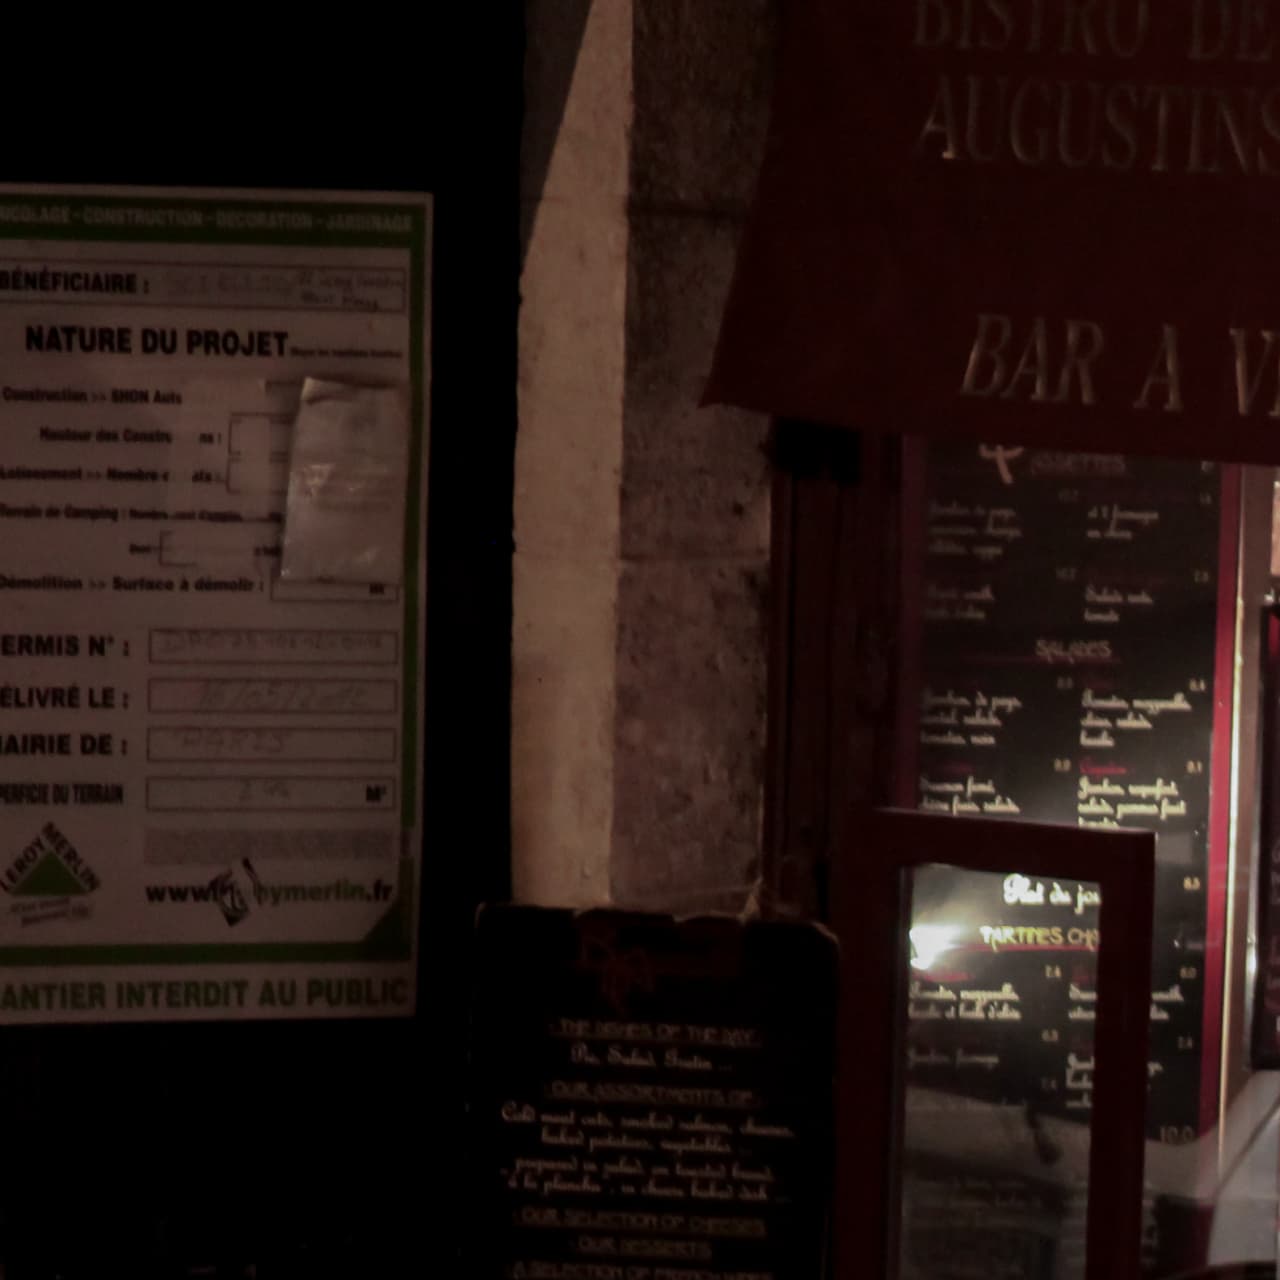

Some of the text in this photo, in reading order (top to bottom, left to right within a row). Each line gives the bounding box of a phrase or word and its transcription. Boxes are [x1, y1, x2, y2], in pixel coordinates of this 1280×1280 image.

[912, 0, 1151, 58] BISTRO
[26, 326, 131, 354] NATURE
[142, 328, 177, 354] DU
[187, 330, 289, 357] PROJET
[959, 313, 1104, 406] BAR
[1132, 323, 1186, 413] A
[113, 575, 173, 593] Surface
[88, 686, 116, 710] LE
[0, 732, 113, 757] AIRIE DE
[117, 980, 249, 1009] INTERDIT
[259, 979, 297, 1007] AU
[306, 977, 408, 1007] PUBLIC
